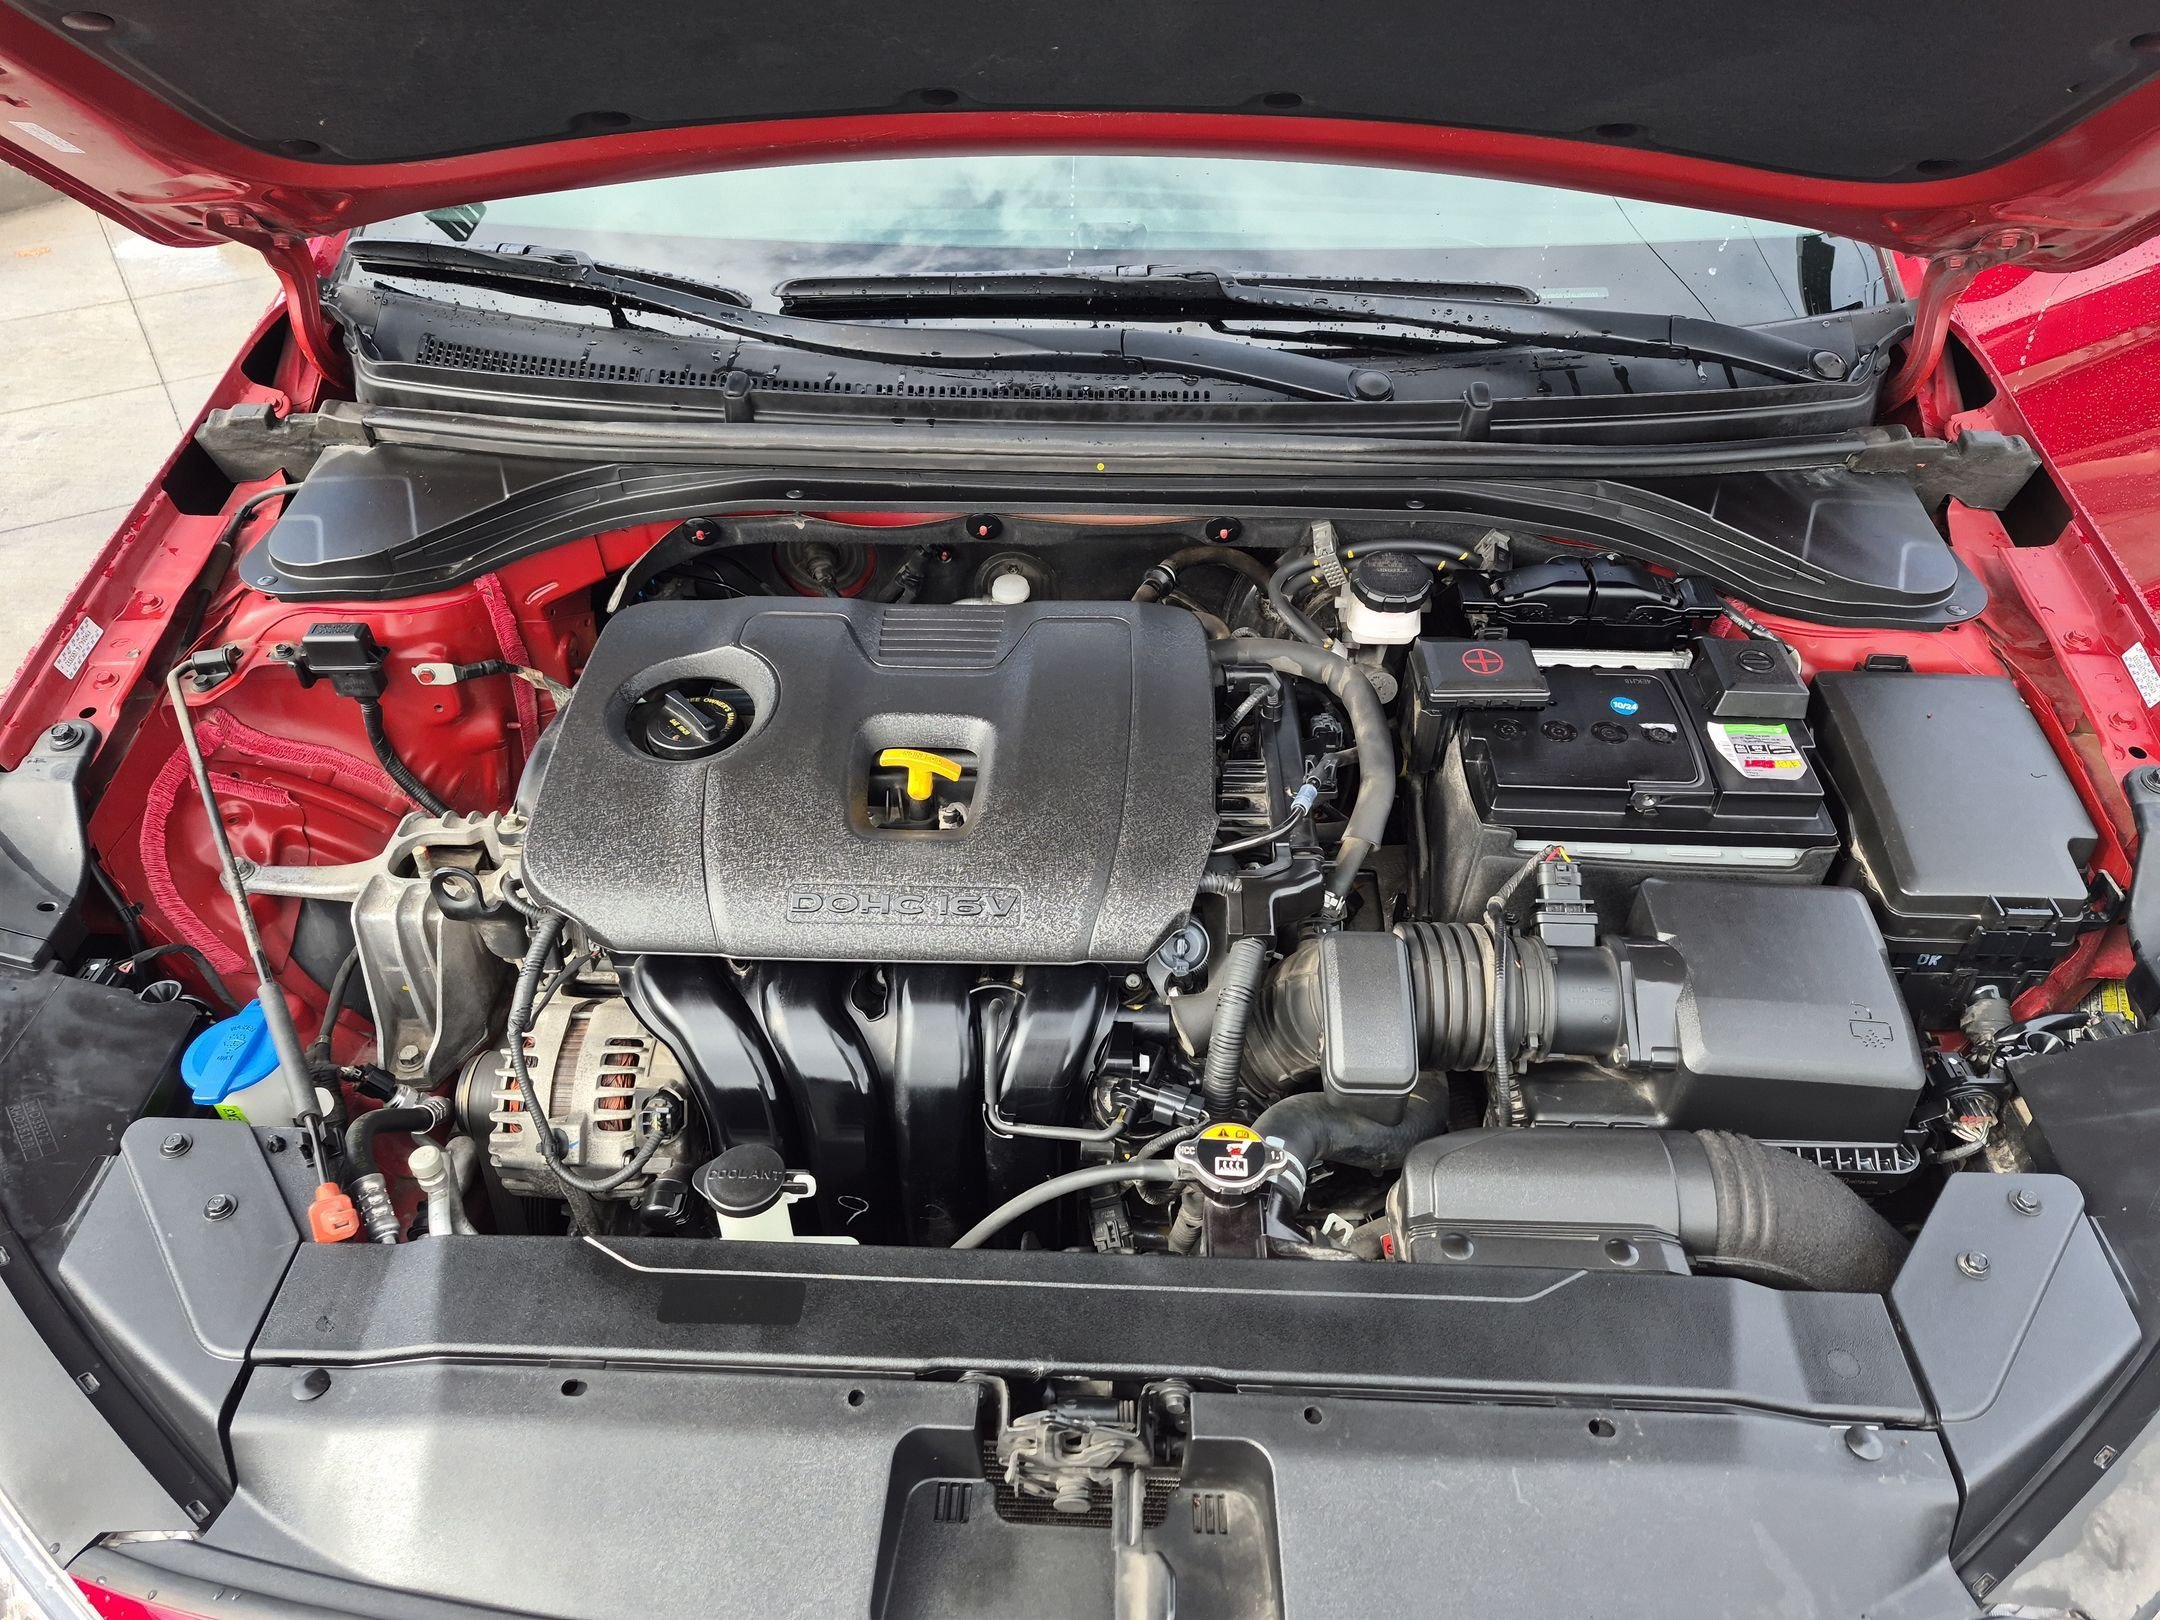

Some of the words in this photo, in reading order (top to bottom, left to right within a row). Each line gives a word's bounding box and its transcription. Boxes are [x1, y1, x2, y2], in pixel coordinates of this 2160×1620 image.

[1612, 701, 1638, 711] 10/24
[790, 893, 926, 914] DOHC
[937, 895, 1019, 917] 16V
[1917, 953, 1943, 966] OK
[1179, 1145, 1196, 1156] HCC
[708, 1168, 783, 1181] COOLANT
